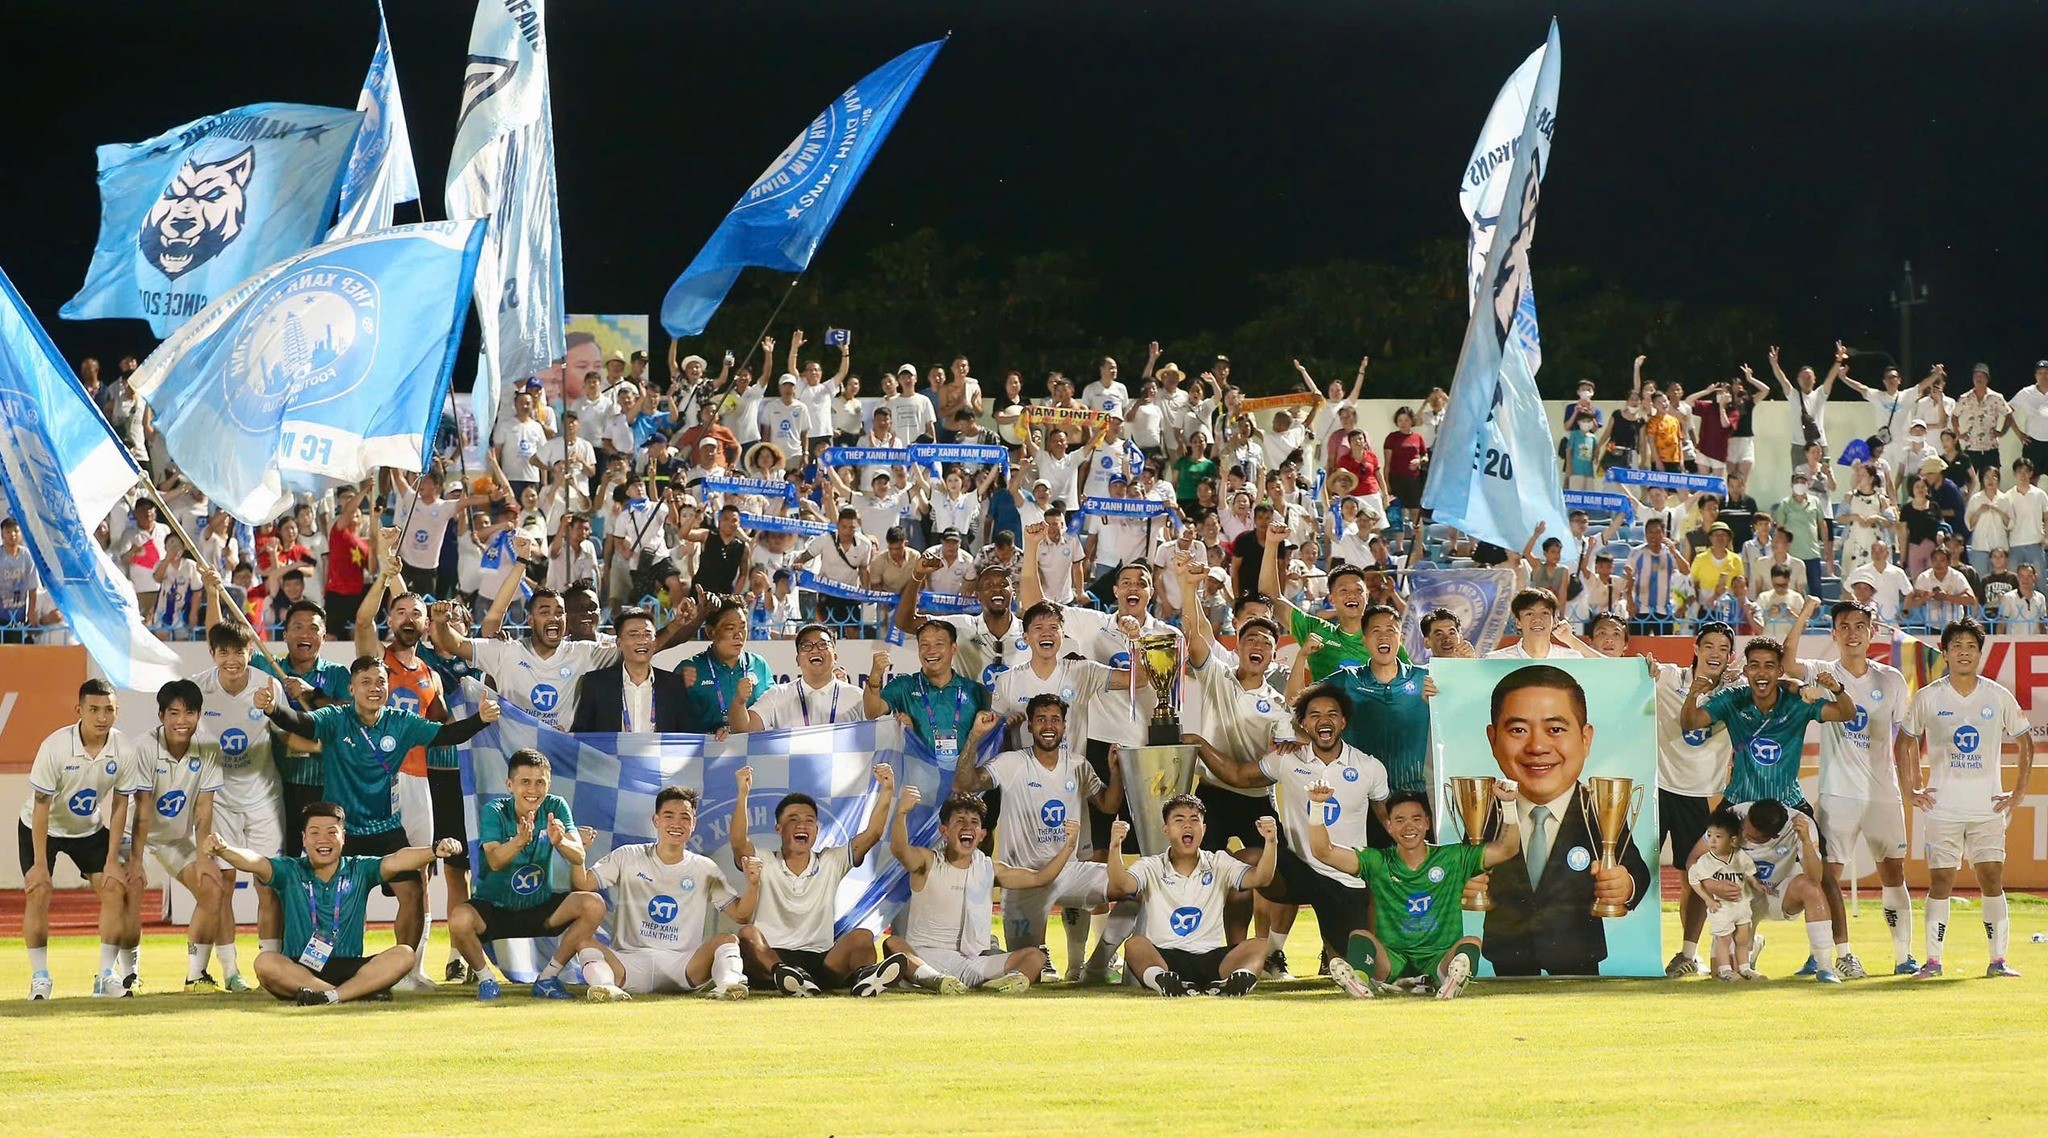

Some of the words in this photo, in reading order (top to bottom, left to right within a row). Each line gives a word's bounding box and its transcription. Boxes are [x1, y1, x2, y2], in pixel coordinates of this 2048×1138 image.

[788, 142, 822, 176] NAM
[750, 171, 791, 199] DINH
[1026, 406, 1055, 418] NAM
[1060, 409, 1092, 420] DINH
[865, 450, 887, 461] XANH
[888, 451, 907, 461] NAM
[917, 446, 936, 458] THÉP
[938, 447, 960, 458] XANH
[961, 448, 980, 459] NAM
[705, 476, 731, 484] NAM
[732, 477, 759, 487] DINH
[760, 479, 787, 490] FANS
[1647, 471, 1668, 482] XANH
[1669, 474, 1688, 485] NAM
[1099, 502, 1123, 512] XANH
[1124, 503, 1144, 512] NAM
[1583, 495, 1602, 505] NAM
[748, 513, 773, 523] NAM
[774, 515, 801, 527] DINH
[802, 519, 829, 531] FANS
[812, 574, 838, 588] NAM
[932, 593, 956, 605] NAM
[533, 688, 557, 707] XT
[222, 734, 247, 750] XT
[1956, 732, 1977, 749] XT
[1754, 743, 1779, 760] XT
[1043, 805, 1065, 823] XT
[516, 869, 542, 890] XT
[650, 900, 677, 919] XT
[1408, 895, 1432, 913] XT
[1173, 912, 1201, 931] XT
[1885, 907, 1899, 928] Mitre
[660, 924, 679, 933] XANH
[310, 949, 323, 959] CLB
